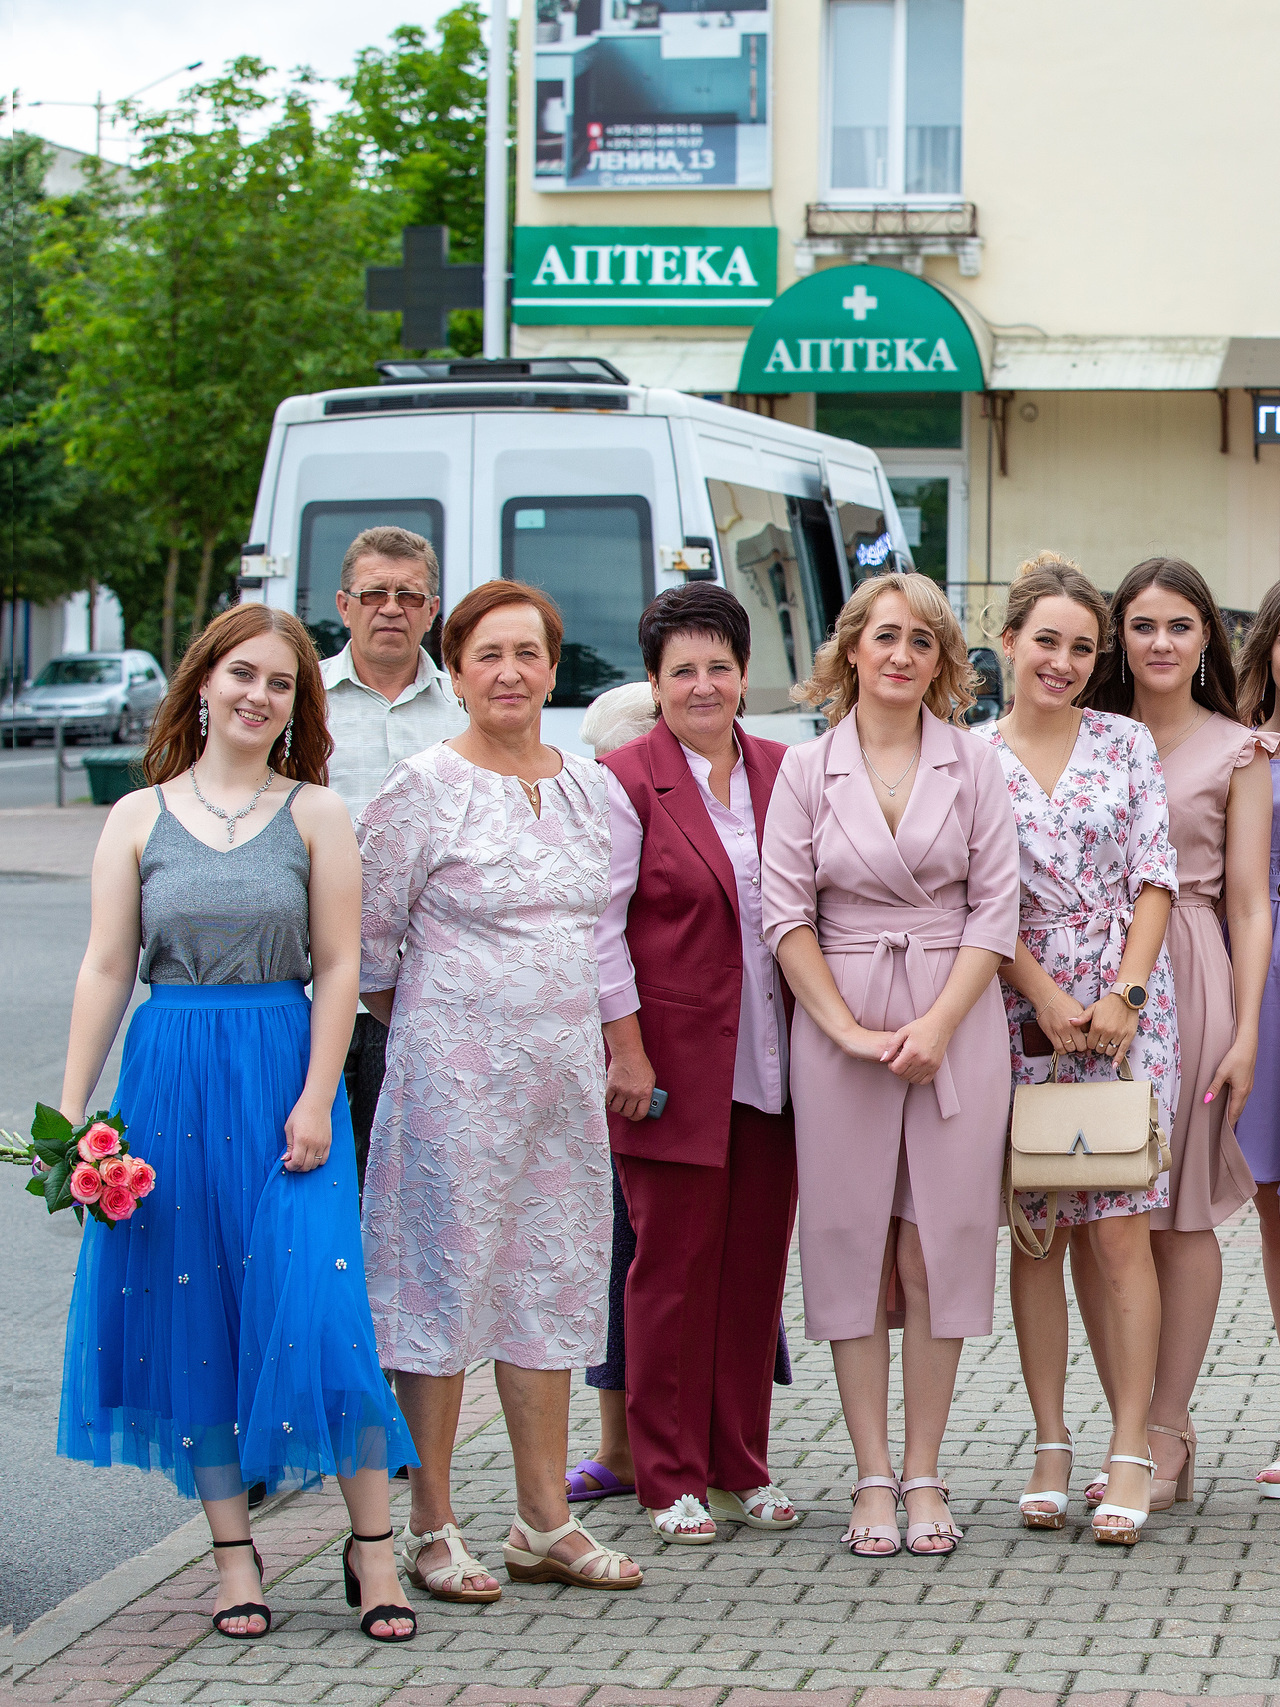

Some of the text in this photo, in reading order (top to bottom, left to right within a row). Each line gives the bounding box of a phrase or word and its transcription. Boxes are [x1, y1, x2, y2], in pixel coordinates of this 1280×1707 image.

[586, 149, 716, 172] ЛЕНИНА, 13
[532, 244, 759, 287] АПТЕКА
[763, 337, 959, 373] АПТЕКА
